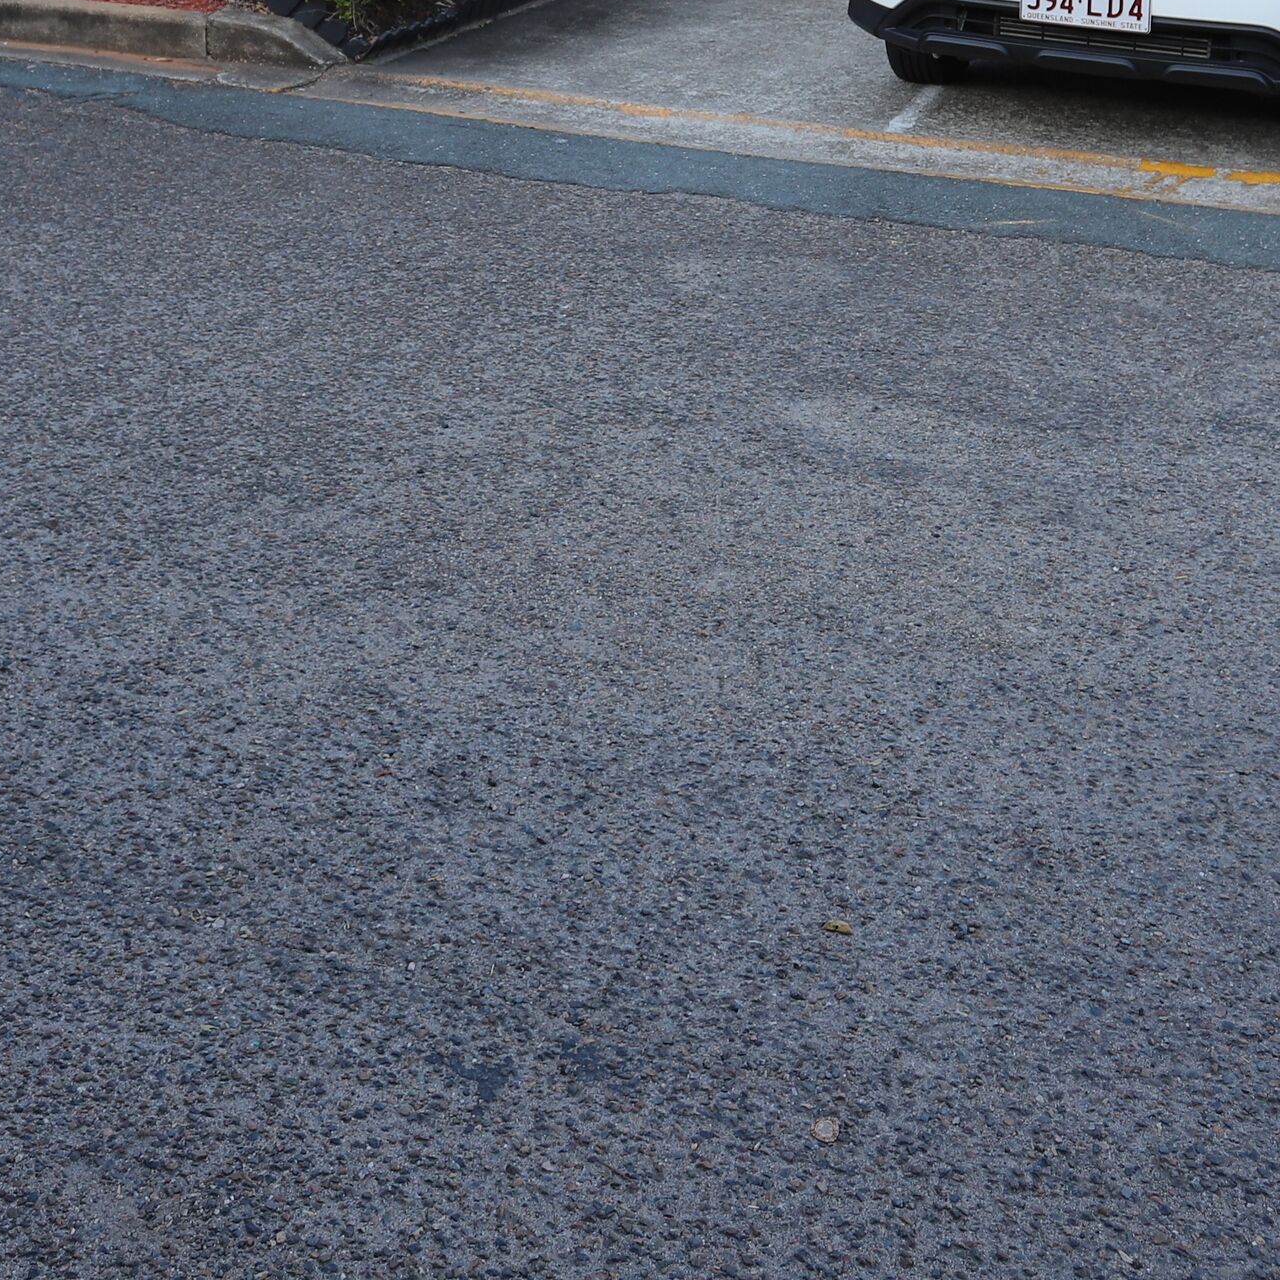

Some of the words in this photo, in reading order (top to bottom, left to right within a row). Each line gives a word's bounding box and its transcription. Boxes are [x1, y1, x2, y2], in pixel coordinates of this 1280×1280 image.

[1026, 12, 1074, 23] QUEENSLAND
[1081, 17, 1116, 28] SUNSHINE
[1120, 21, 1143, 31] STATE
